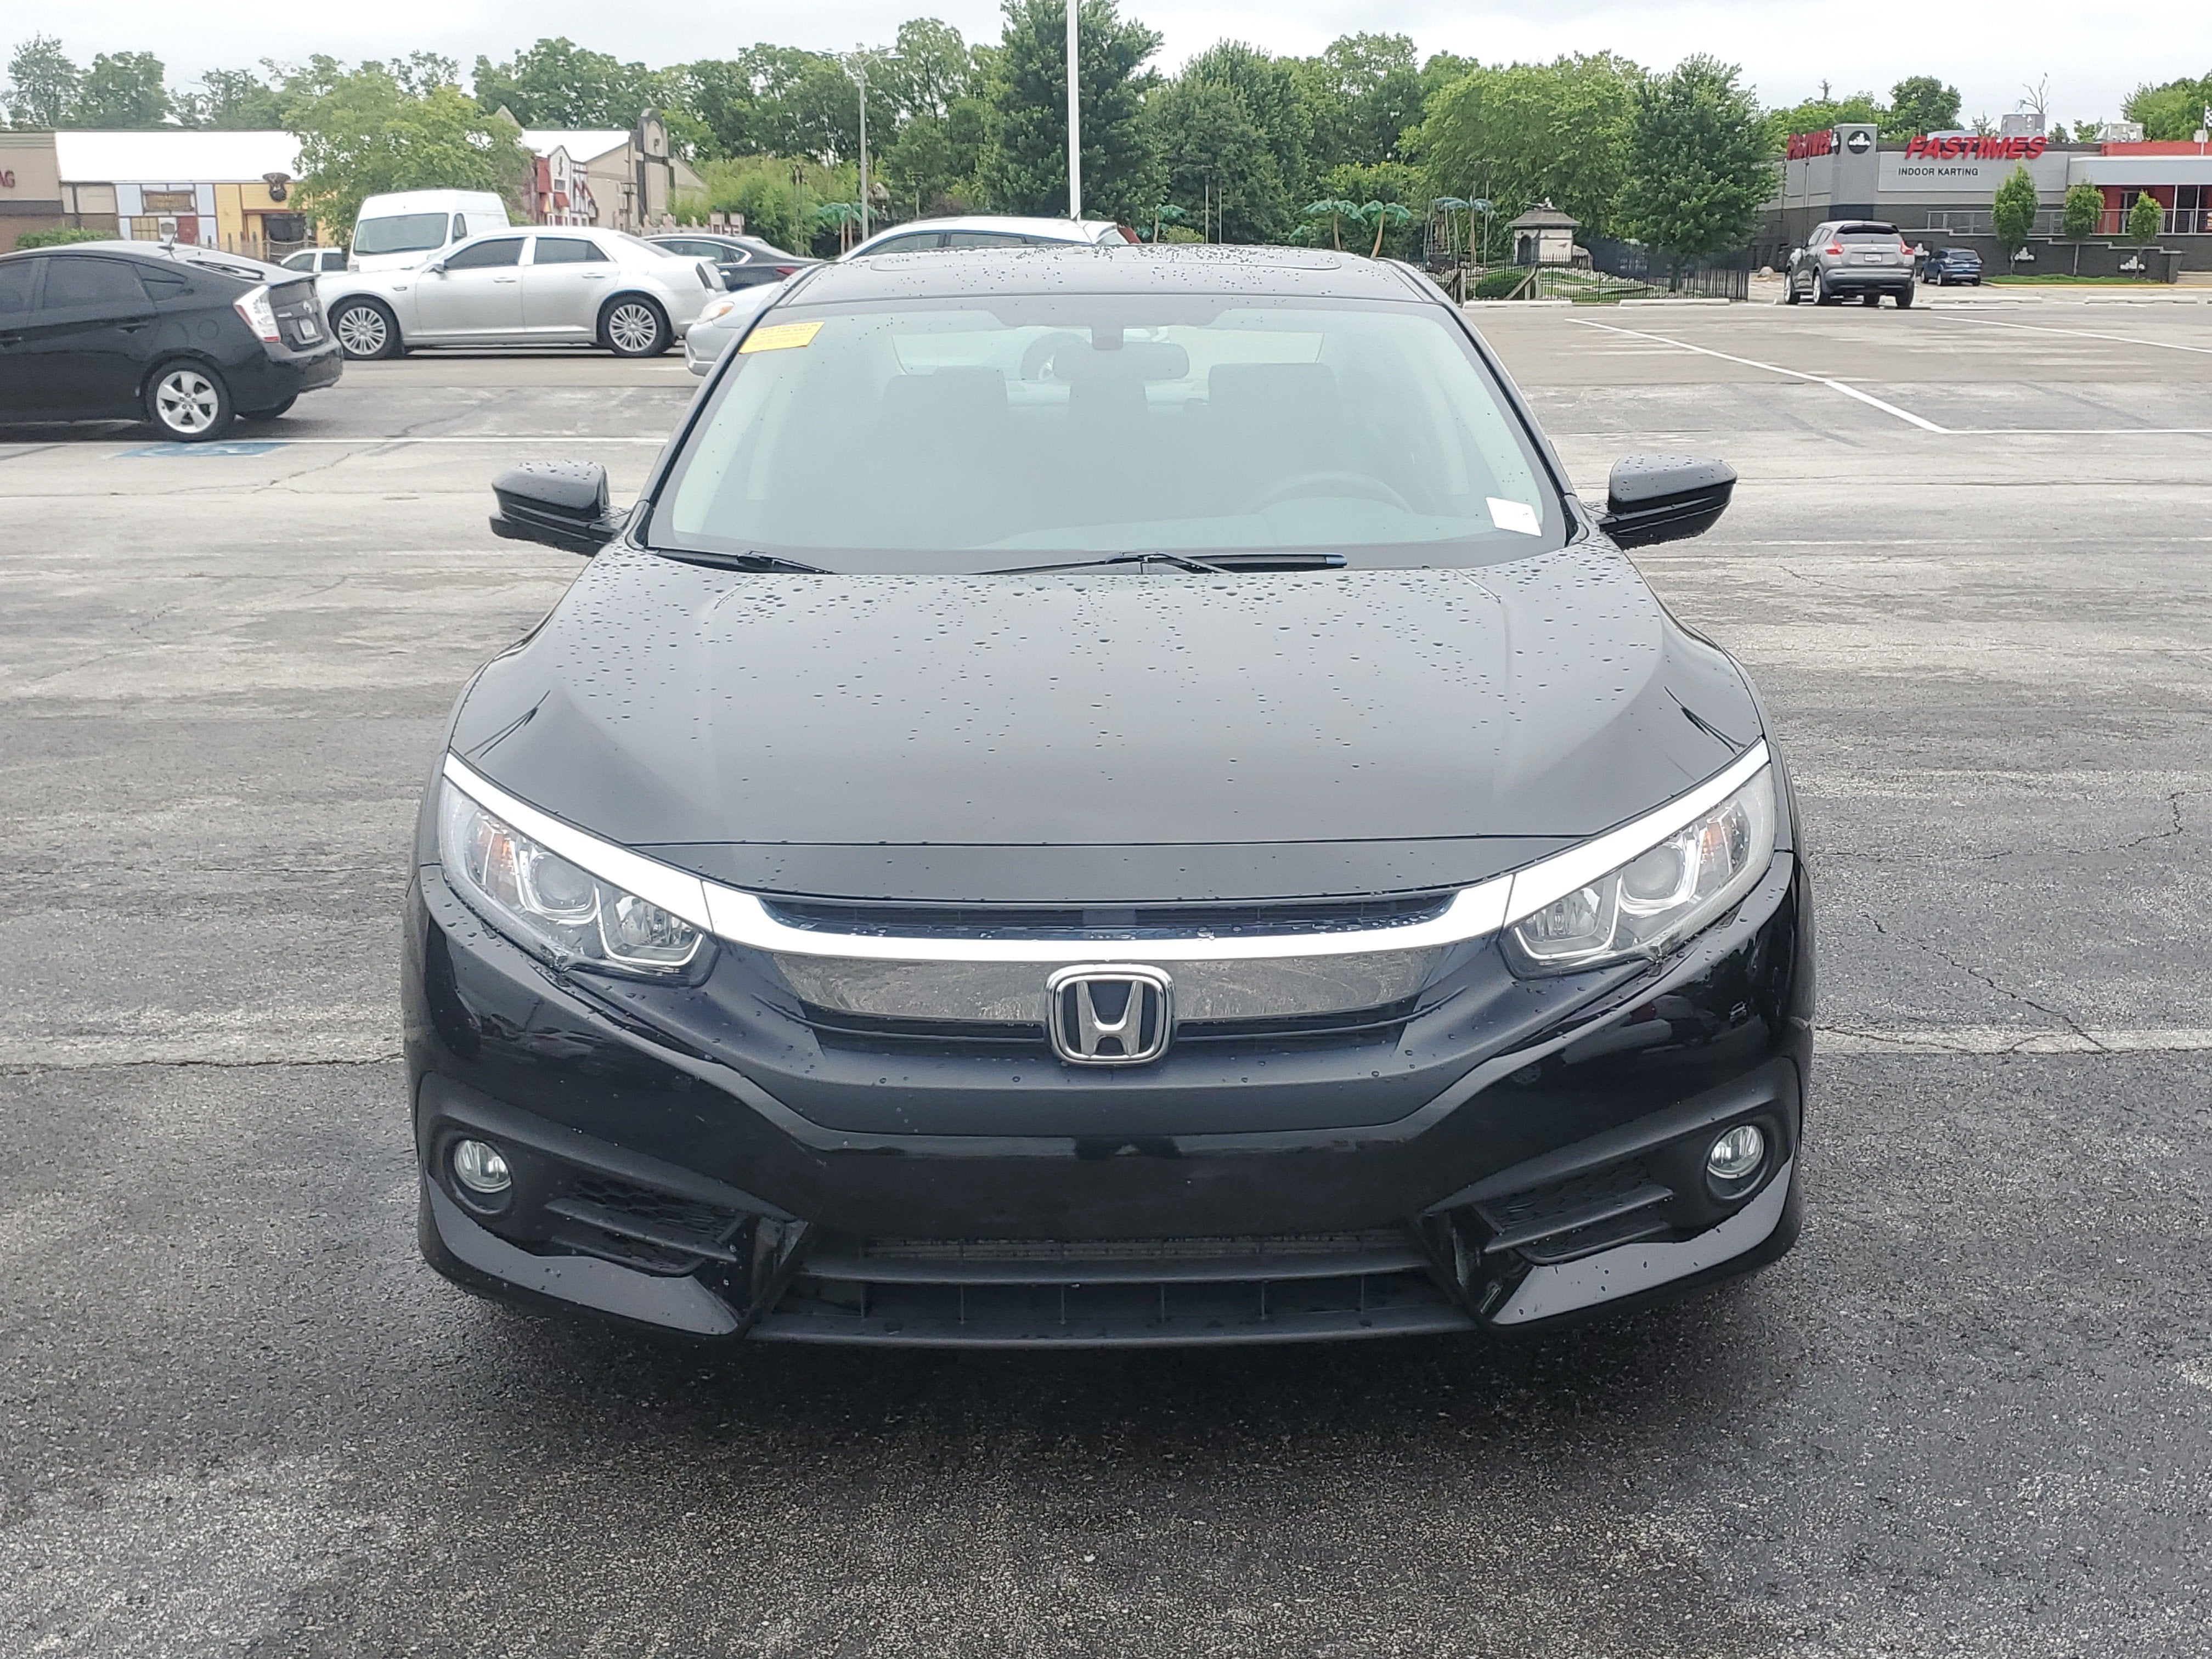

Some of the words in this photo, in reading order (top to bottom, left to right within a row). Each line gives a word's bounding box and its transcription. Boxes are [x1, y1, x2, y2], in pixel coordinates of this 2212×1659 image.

[1905, 136, 2047, 160] FASTIMES
[1898, 167, 1934, 176] INDOOR
[1938, 167, 1978, 176] KARTING
